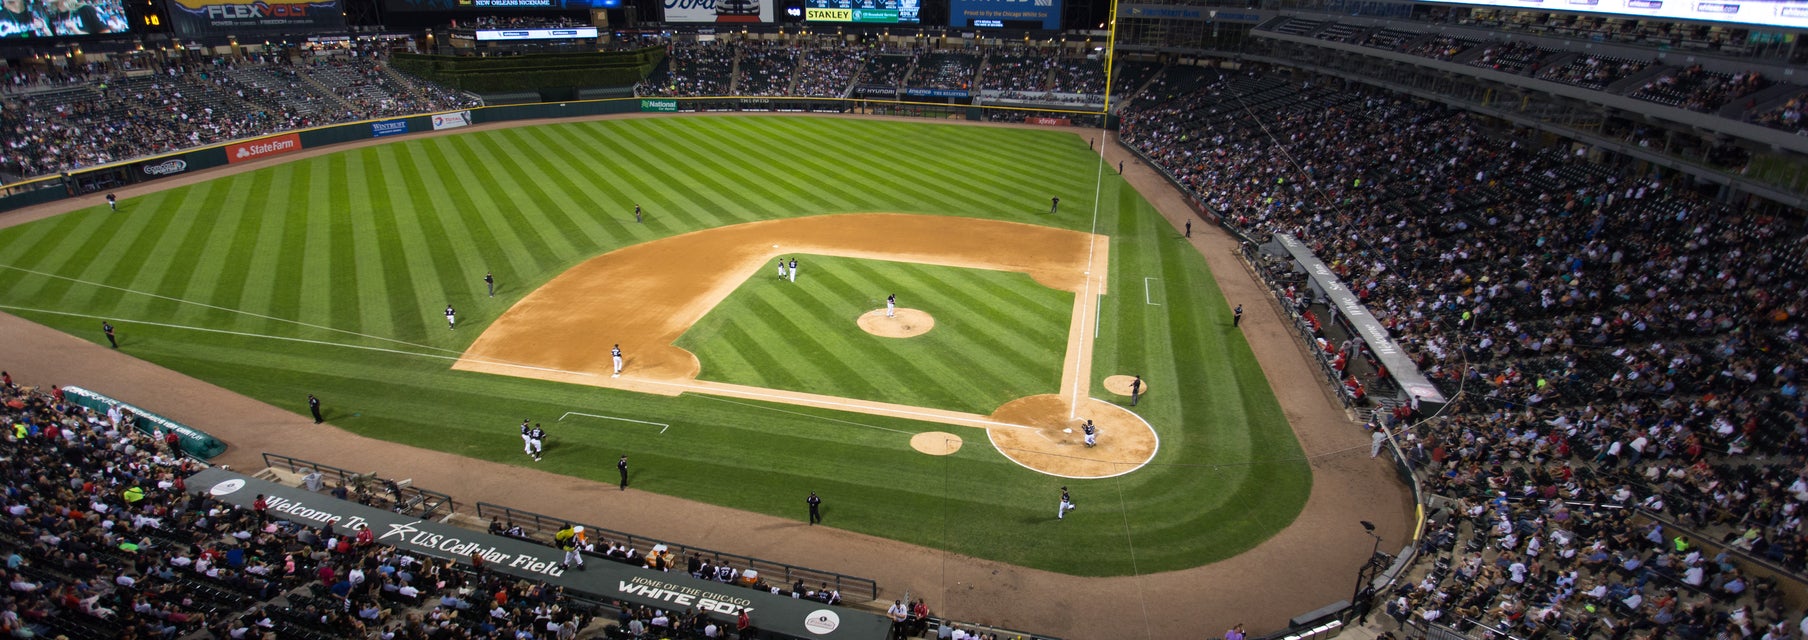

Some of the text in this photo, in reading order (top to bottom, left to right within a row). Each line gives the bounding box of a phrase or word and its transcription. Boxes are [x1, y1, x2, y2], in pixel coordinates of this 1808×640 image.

[207, 3, 309, 19] FLEXVOLT
[808, 10, 849, 19] STANLEY
[372, 121, 406, 130] WINTRUST
[1038, 118, 1057, 126] xfinity
[1342, 297, 1364, 316] White
[265, 495, 369, 532] Welcome To
[410, 530, 443, 549] U.S.
[439, 536, 510, 565] Cellular
[618, 580, 755, 616] WHITE SOX
[631, 576, 751, 607] HOME OF THE CHICAGO
